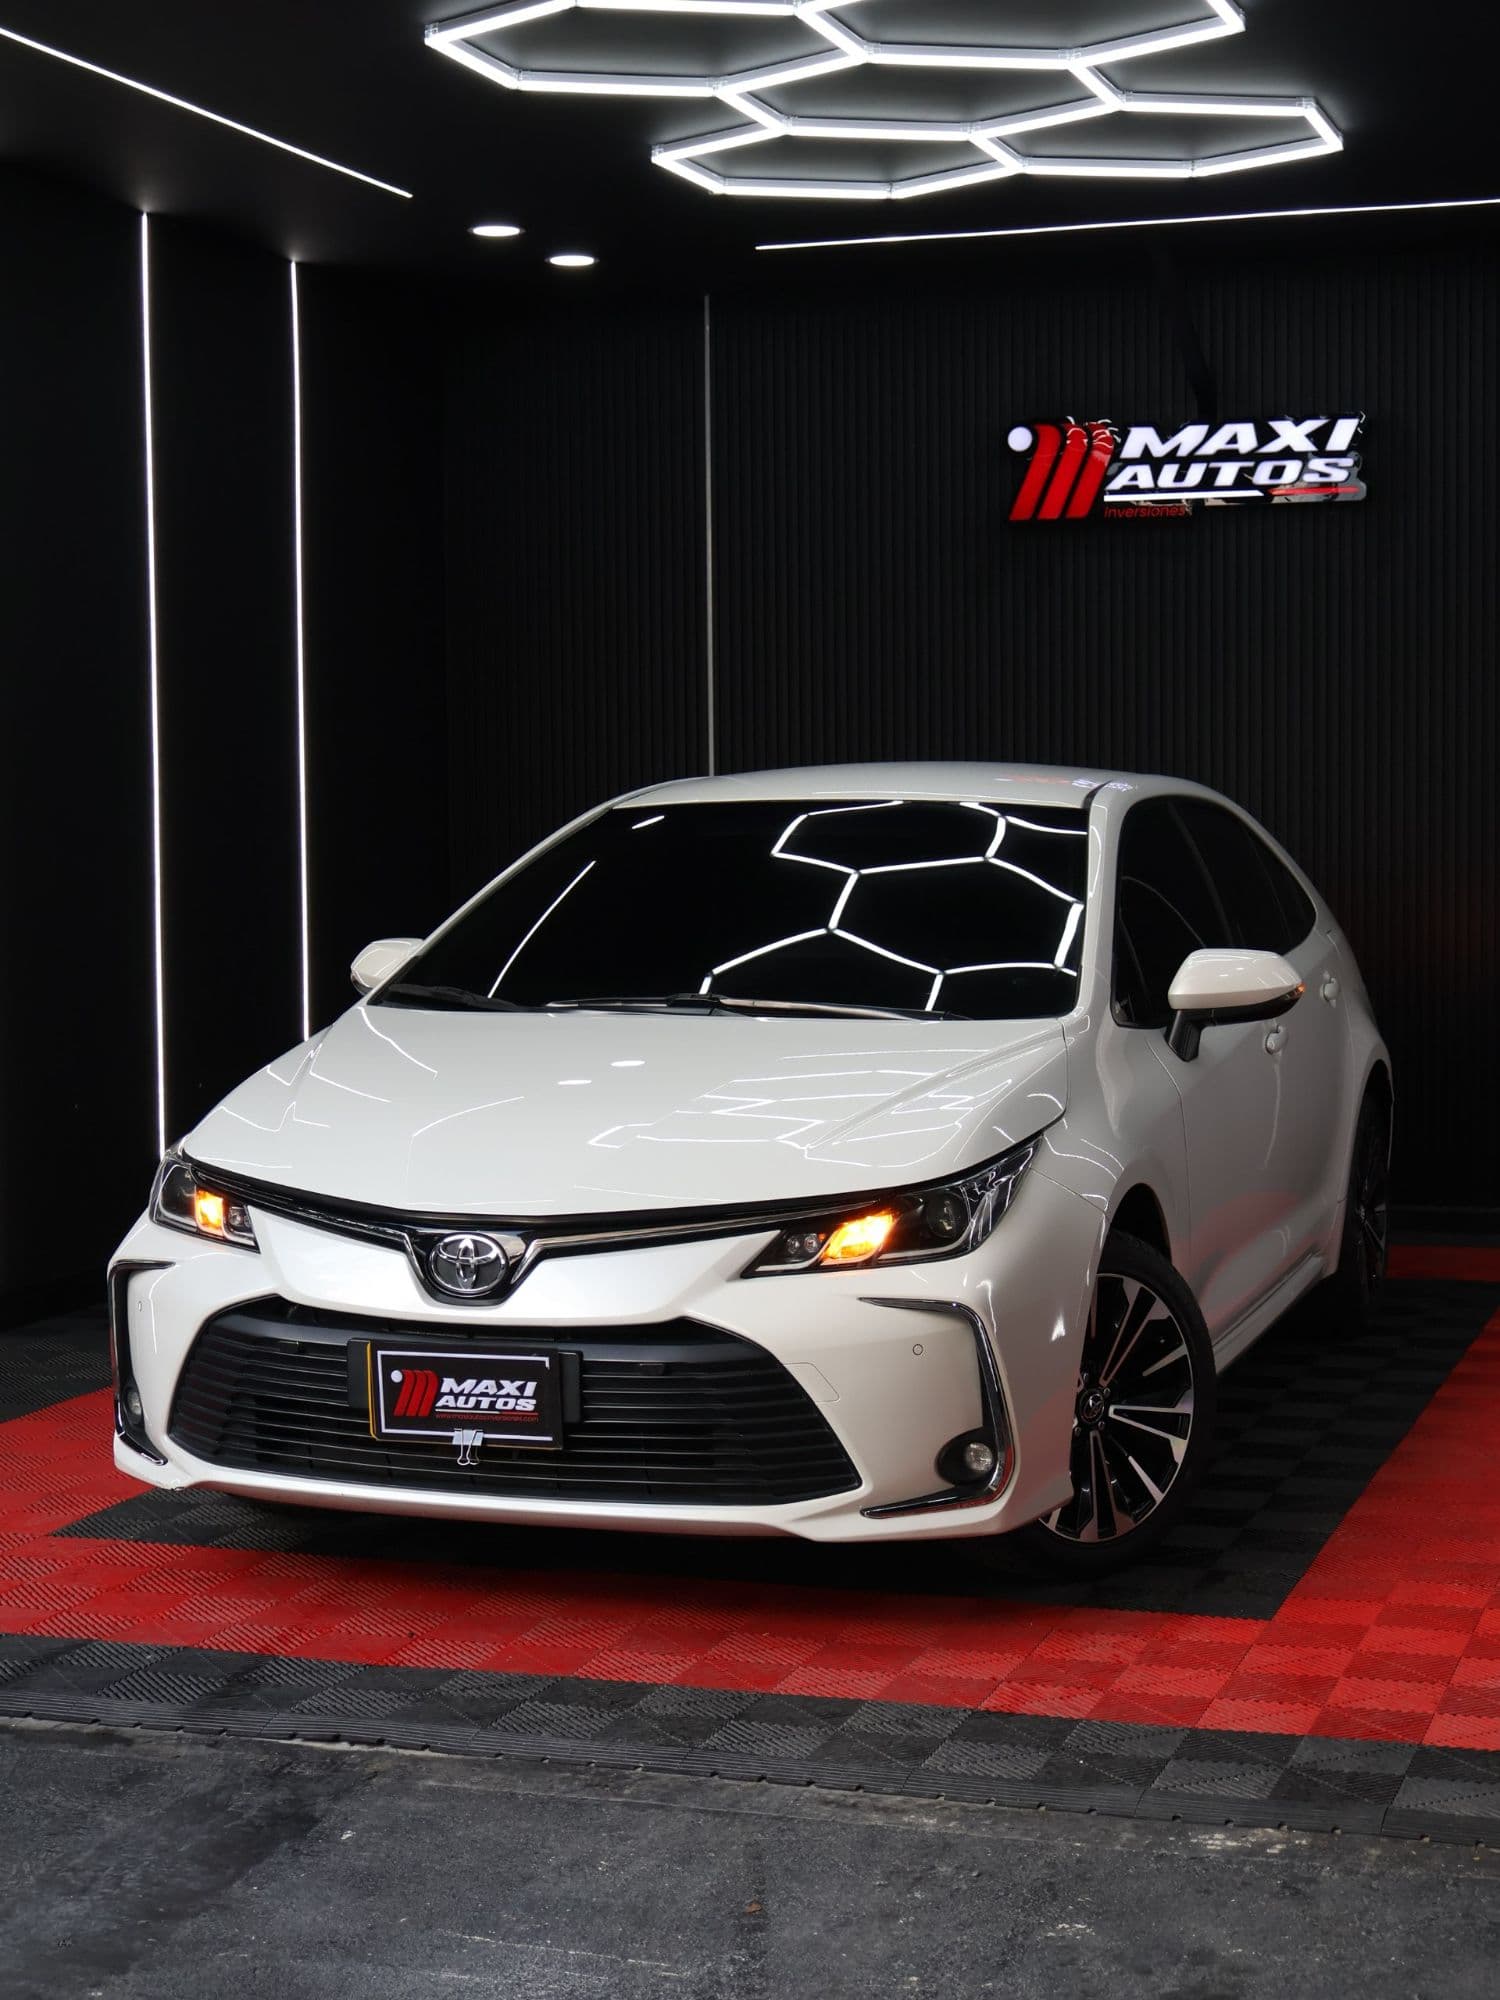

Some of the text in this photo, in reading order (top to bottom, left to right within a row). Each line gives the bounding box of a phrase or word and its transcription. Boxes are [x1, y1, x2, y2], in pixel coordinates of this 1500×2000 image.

[1120, 418, 1359, 458] MAXI
[1105, 458, 1353, 490] AUTOS
[440, 1377, 537, 1396] MAXI
[435, 1396, 537, 1411] AUTOS
